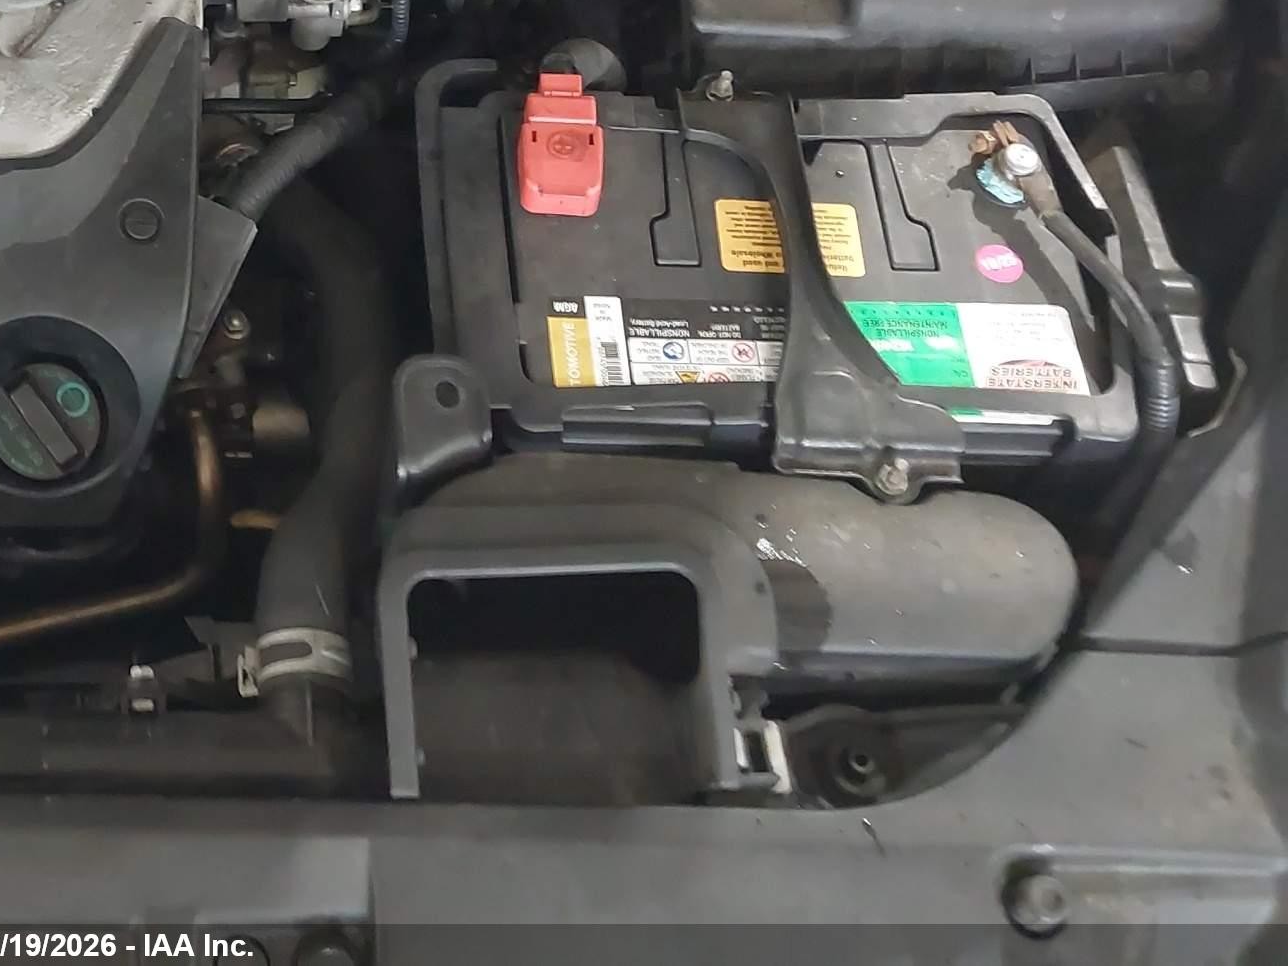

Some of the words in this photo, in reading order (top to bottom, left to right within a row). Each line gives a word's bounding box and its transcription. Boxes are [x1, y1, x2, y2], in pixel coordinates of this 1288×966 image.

[553, 301, 578, 314] AGM
[657, 319, 689, 328] Lead-Acid
[863, 318, 884, 328] FREE
[885, 319, 948, 329] MAINTENANCE
[628, 327, 690, 337] NONSPILLABLE
[875, 328, 940, 339] NONSPILLABLE
[561, 321, 583, 387] TOMOTIVE
[990, 367, 1073, 378] BATTERIES
[986, 378, 1078, 390] INTERSTATE
